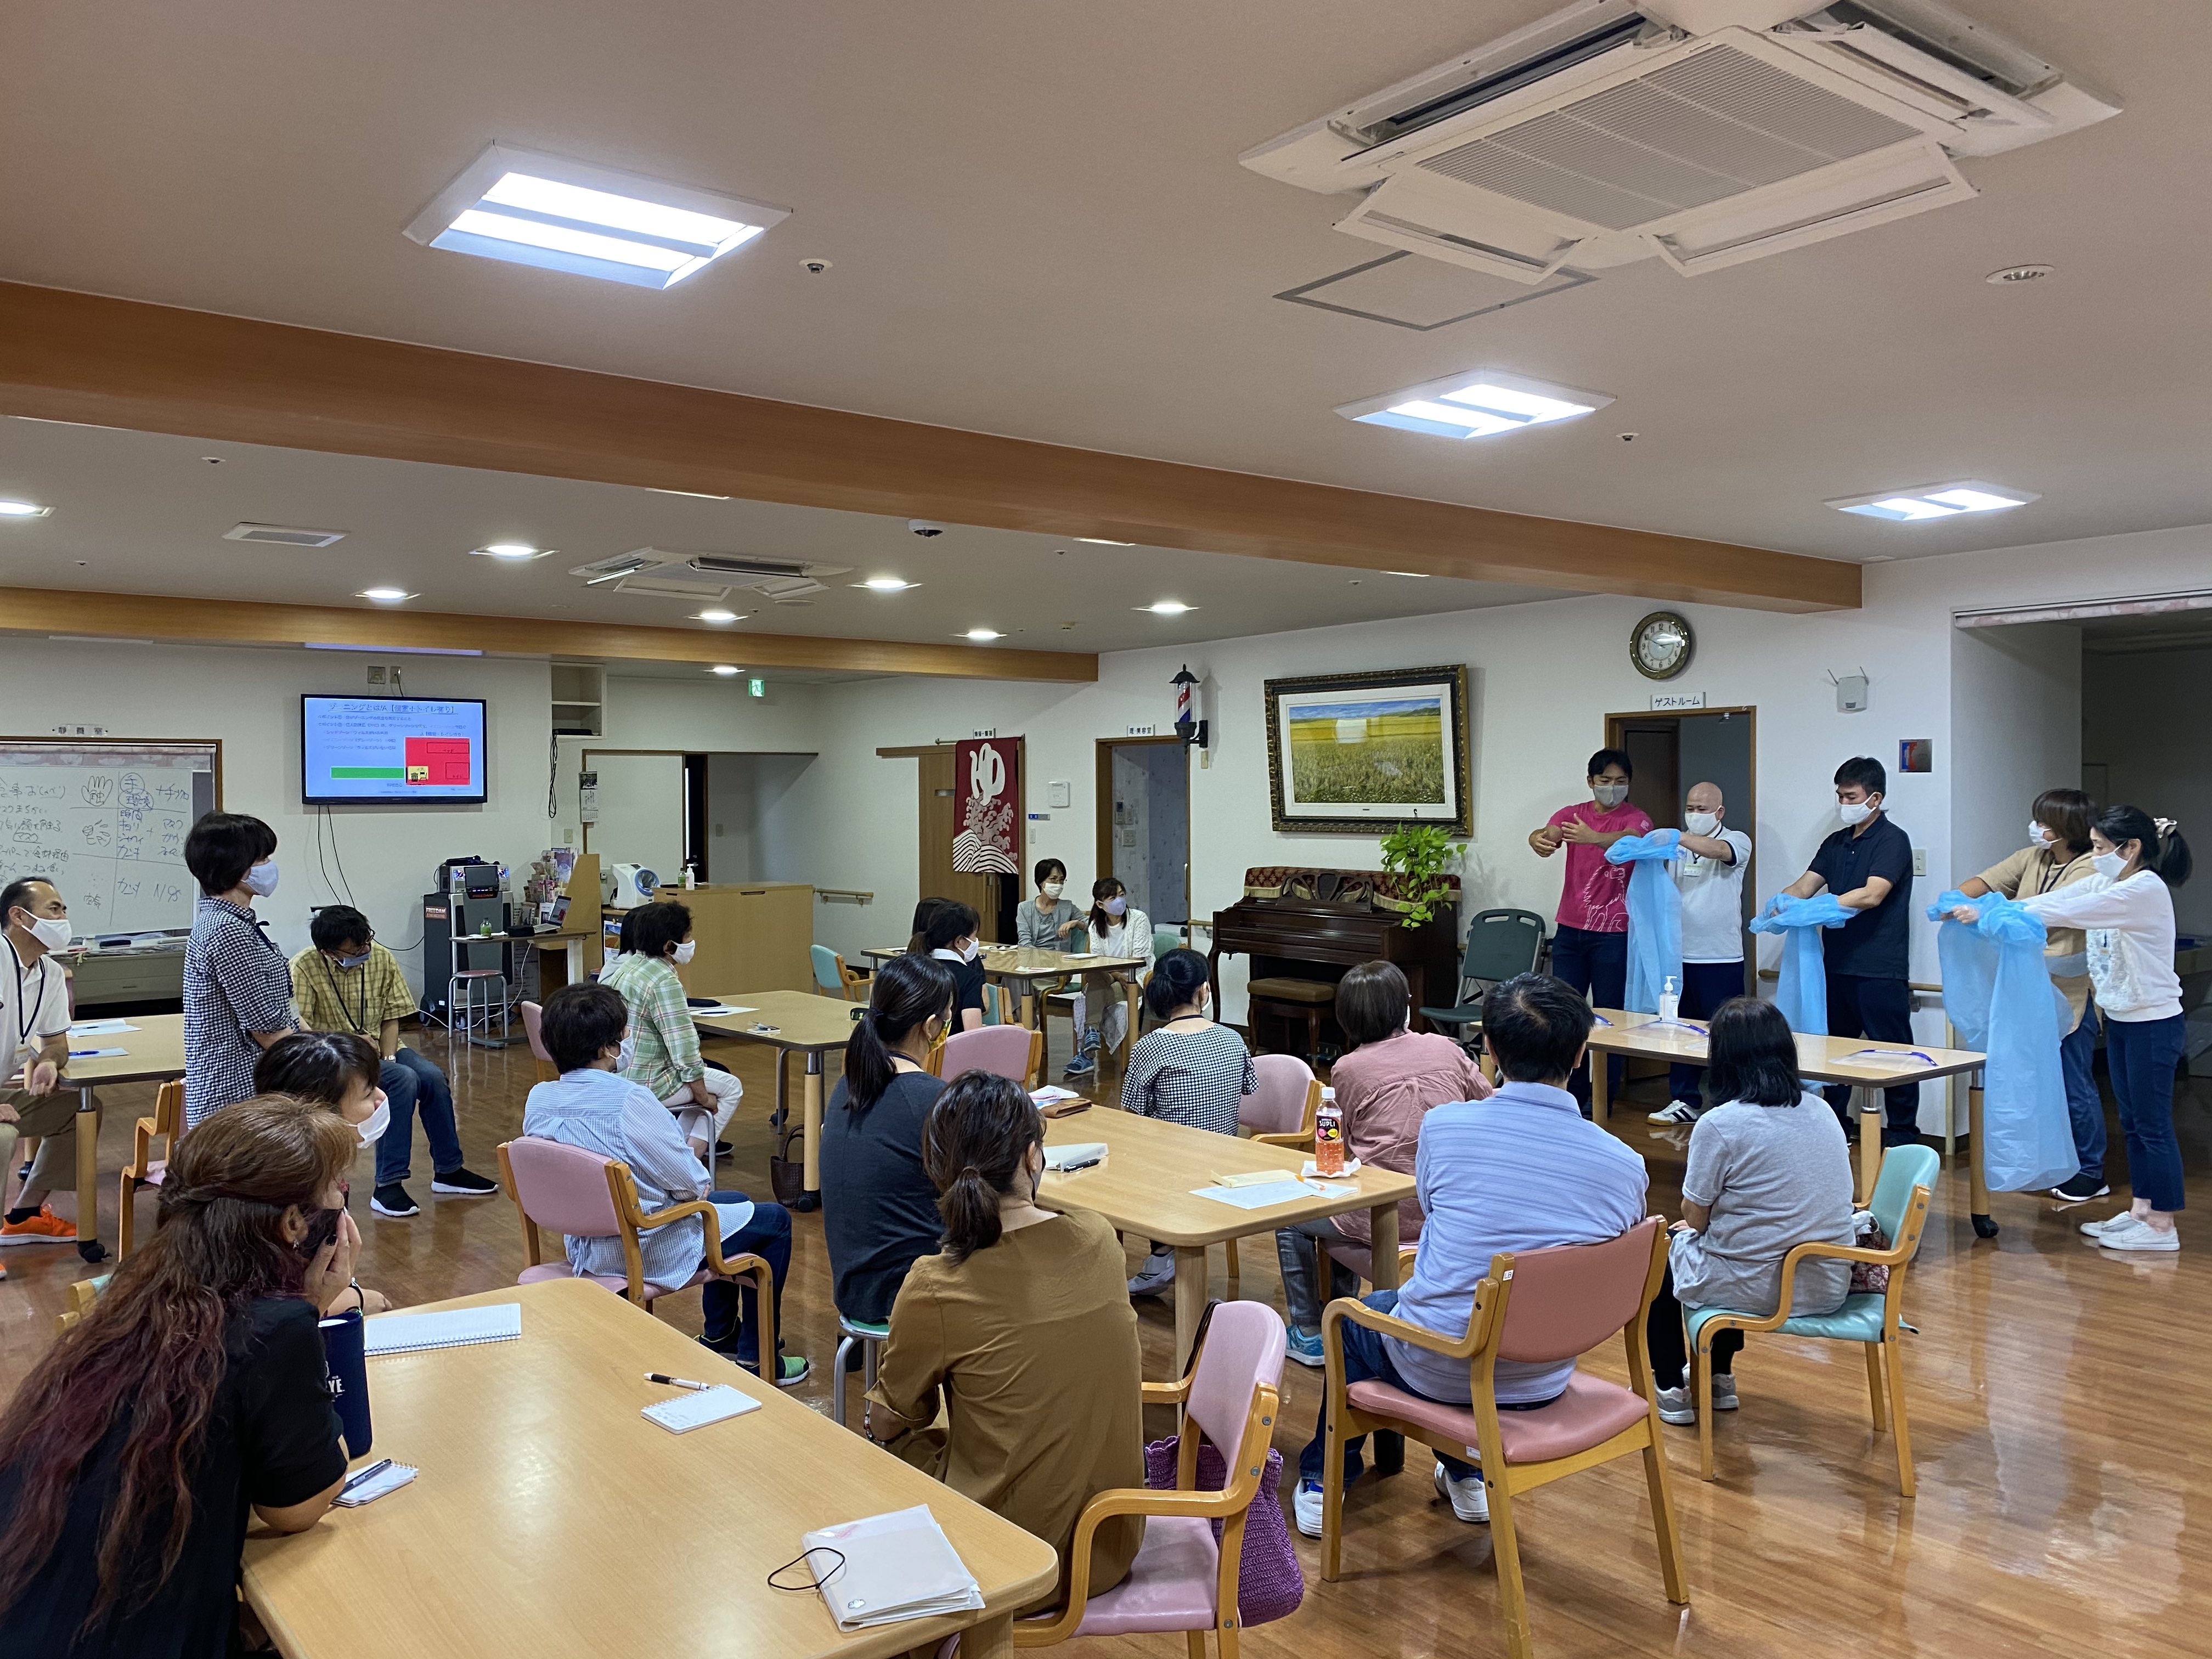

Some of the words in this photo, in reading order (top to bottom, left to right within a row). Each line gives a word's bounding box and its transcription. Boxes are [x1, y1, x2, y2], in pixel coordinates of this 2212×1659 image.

[1655, 696, 1700, 707] ゲストルーム
[969, 742, 1006, 806] ゆ
